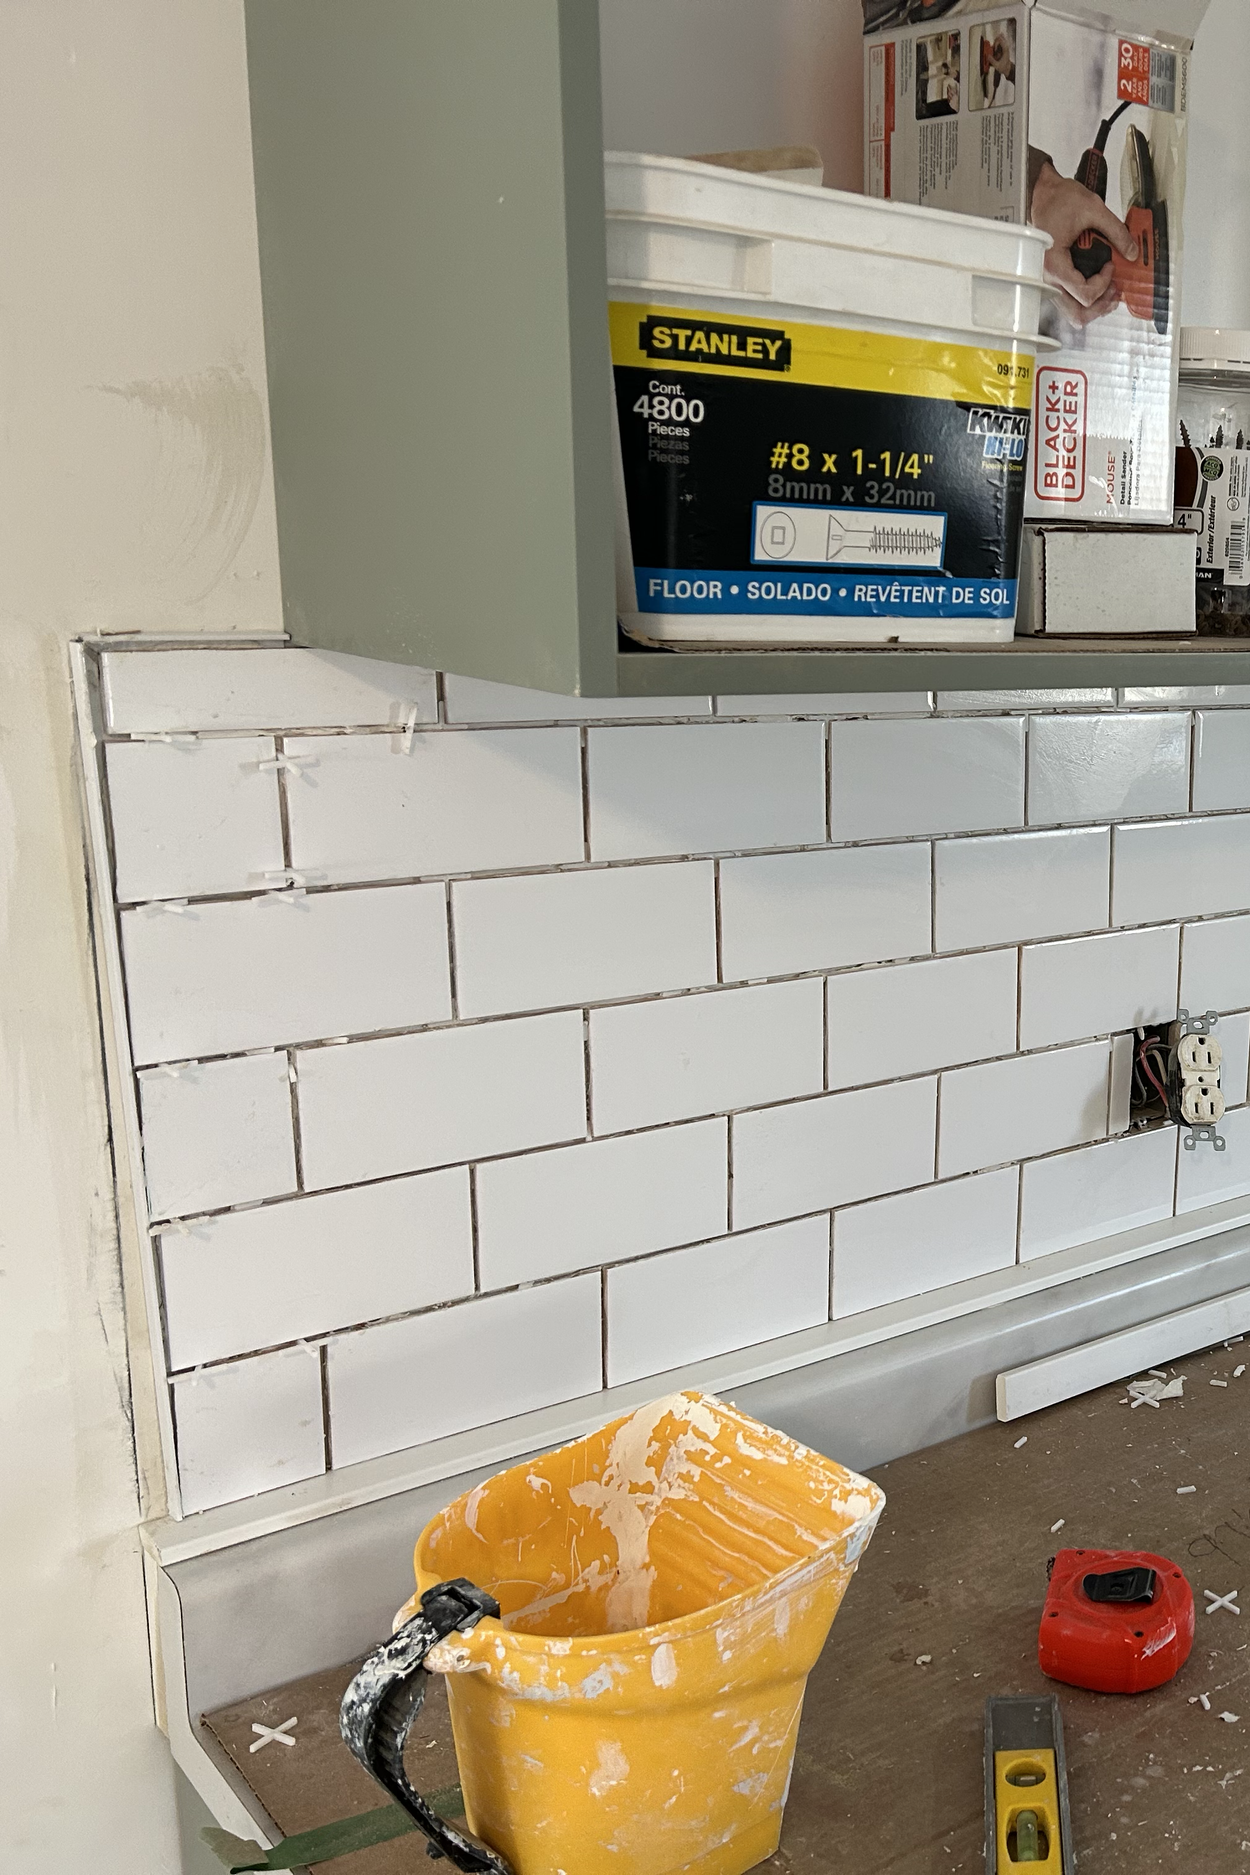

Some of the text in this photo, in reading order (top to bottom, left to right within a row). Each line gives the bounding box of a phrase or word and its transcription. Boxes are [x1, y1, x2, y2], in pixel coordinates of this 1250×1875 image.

[1120, 43, 1133, 71] 30
[1120, 79, 1132, 94] 2
[651, 325, 783, 361] STANLEY
[649, 380, 685, 396] Cont.
[633, 394, 705, 424] 4800
[648, 421, 690, 437] Pieces
[649, 435, 690, 451] Piezas
[1043, 380, 1061, 489] BLACK+
[1061, 380, 1080, 490] DECKER
[648, 449, 690, 465] Pieces
[770, 441, 935, 480] #8 x 1-1/4"
[767, 474, 935, 508] 8mm x 32mm
[1119, 450, 1128, 505] Detail Sander
[1206, 532, 1216, 564] Exterior
[648, 579, 1011, 606] FLOOR SOLADO REVÊTENT DE SOL
